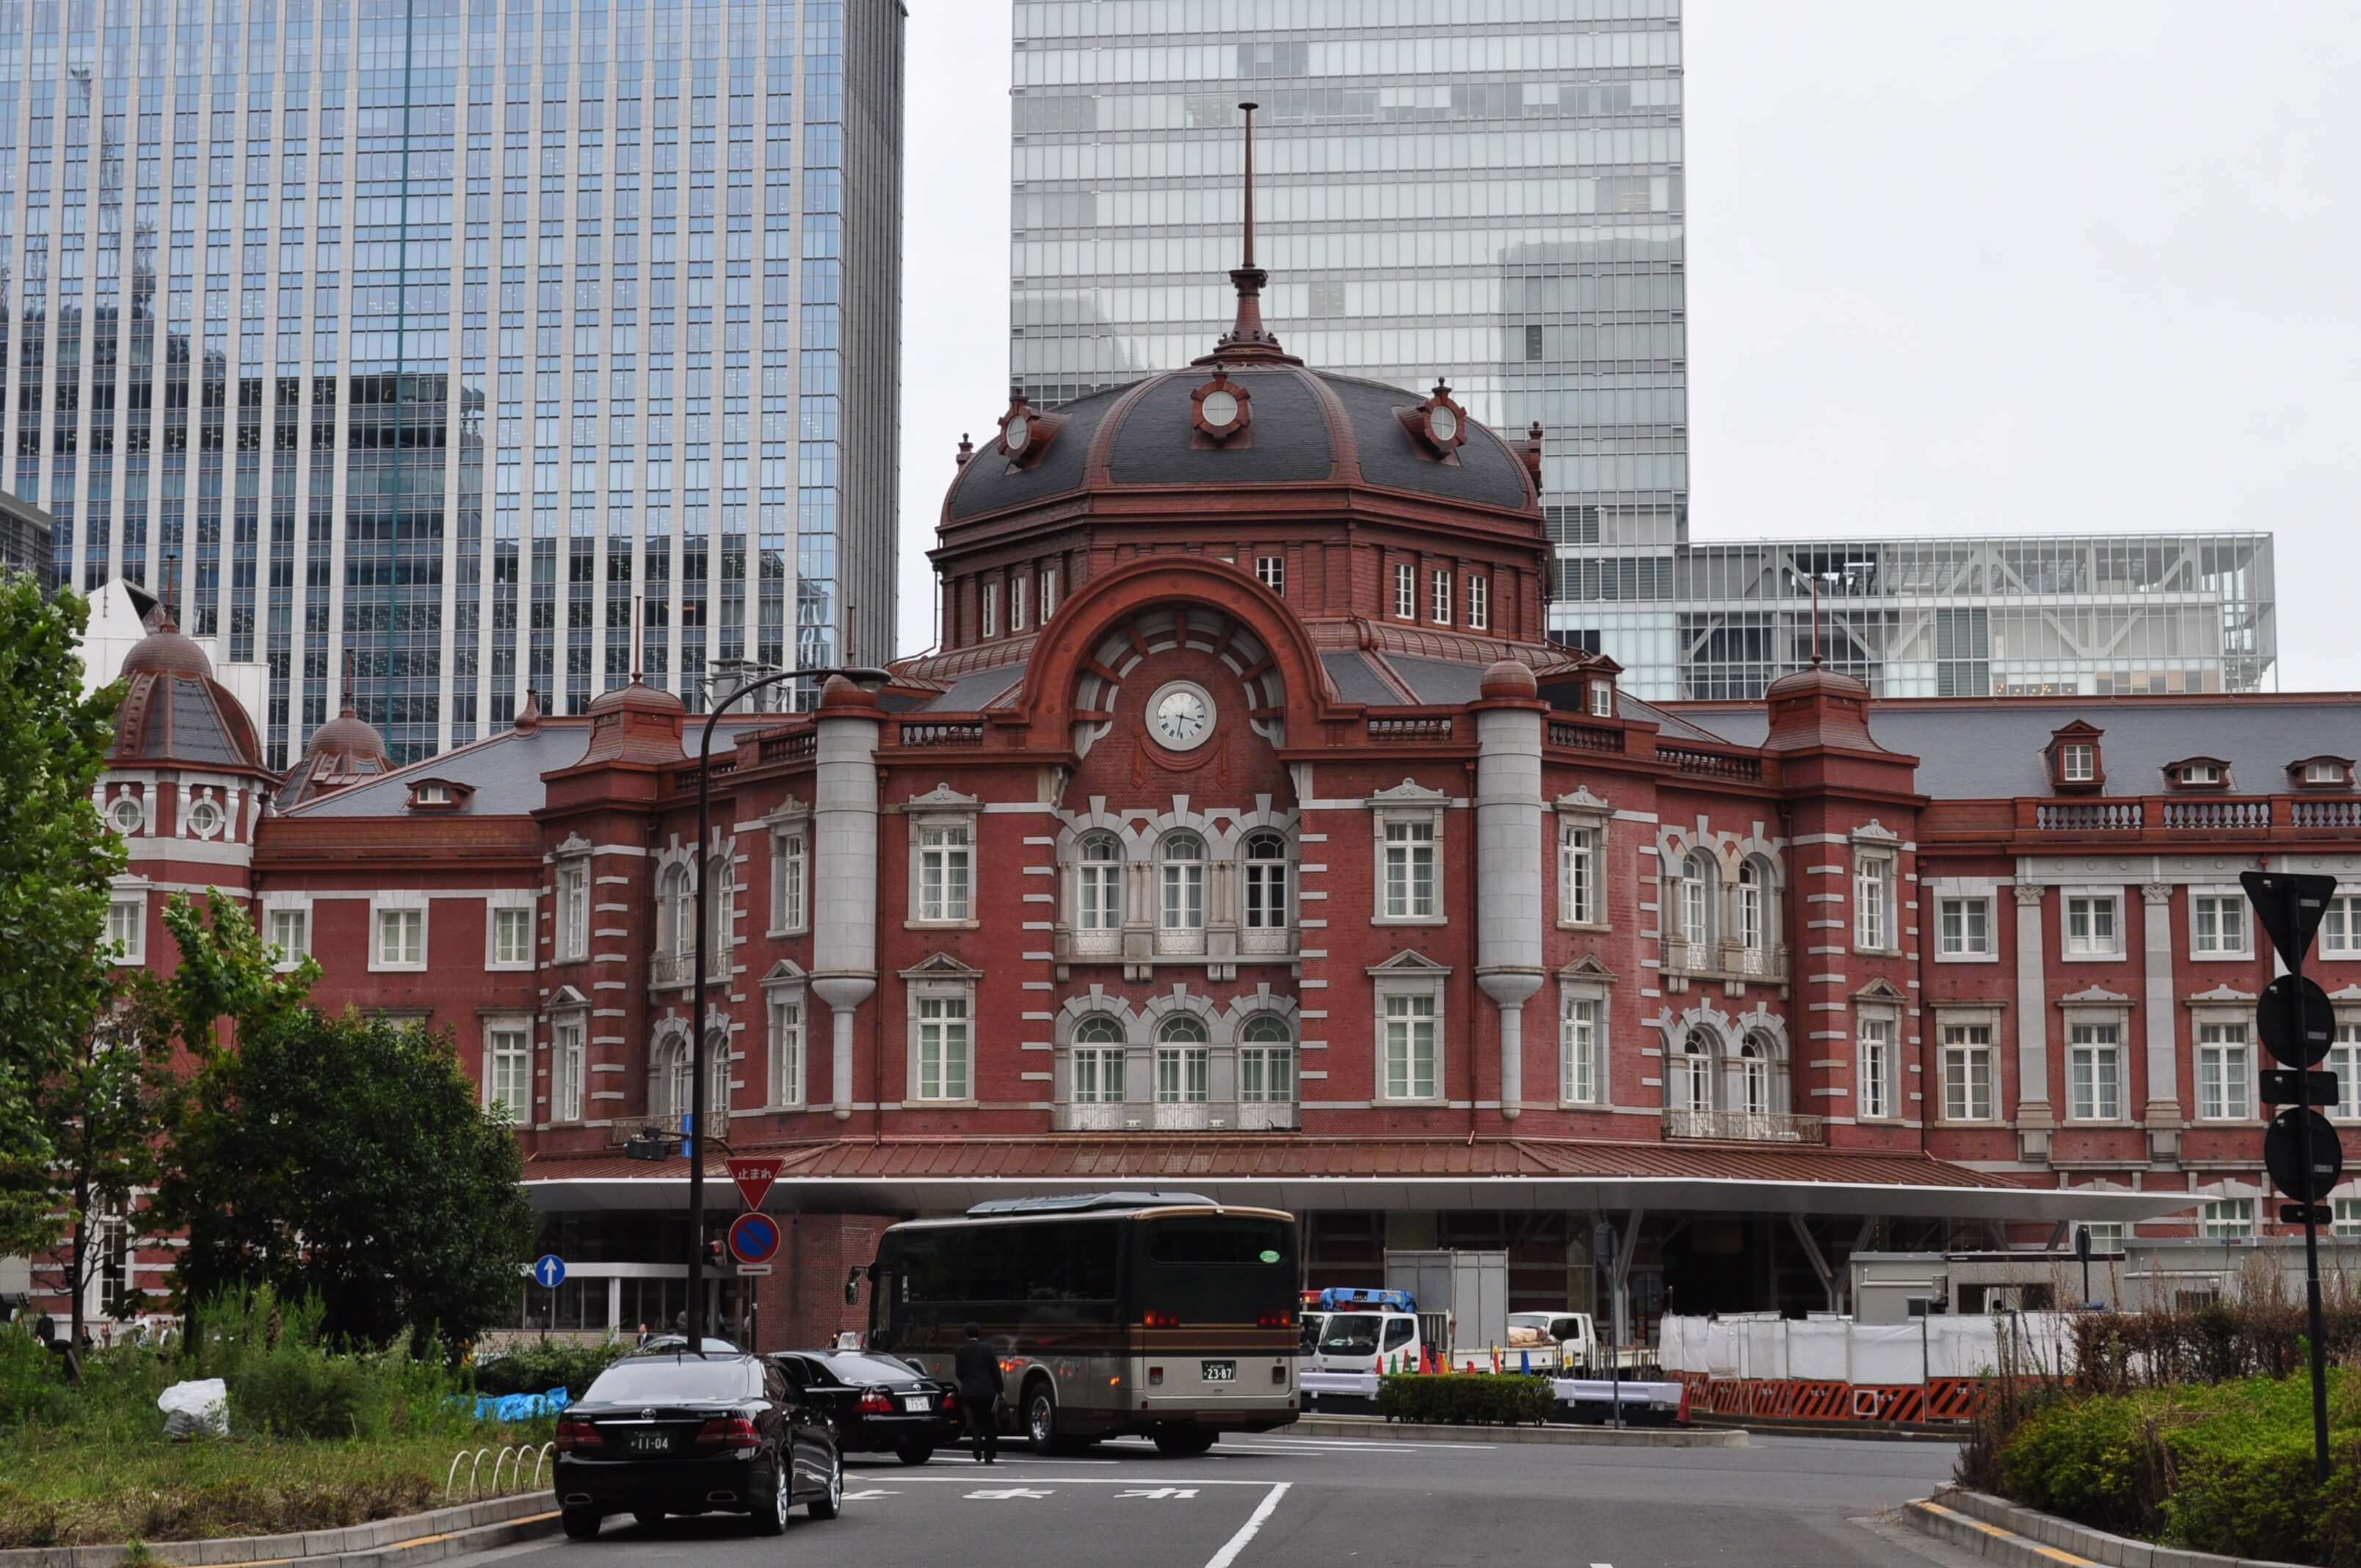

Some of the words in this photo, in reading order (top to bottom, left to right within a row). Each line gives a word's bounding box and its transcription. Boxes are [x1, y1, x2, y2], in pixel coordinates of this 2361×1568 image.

[737, 1168, 772, 1180] 止まれ
[638, 1437, 668, 1450] 11-04
